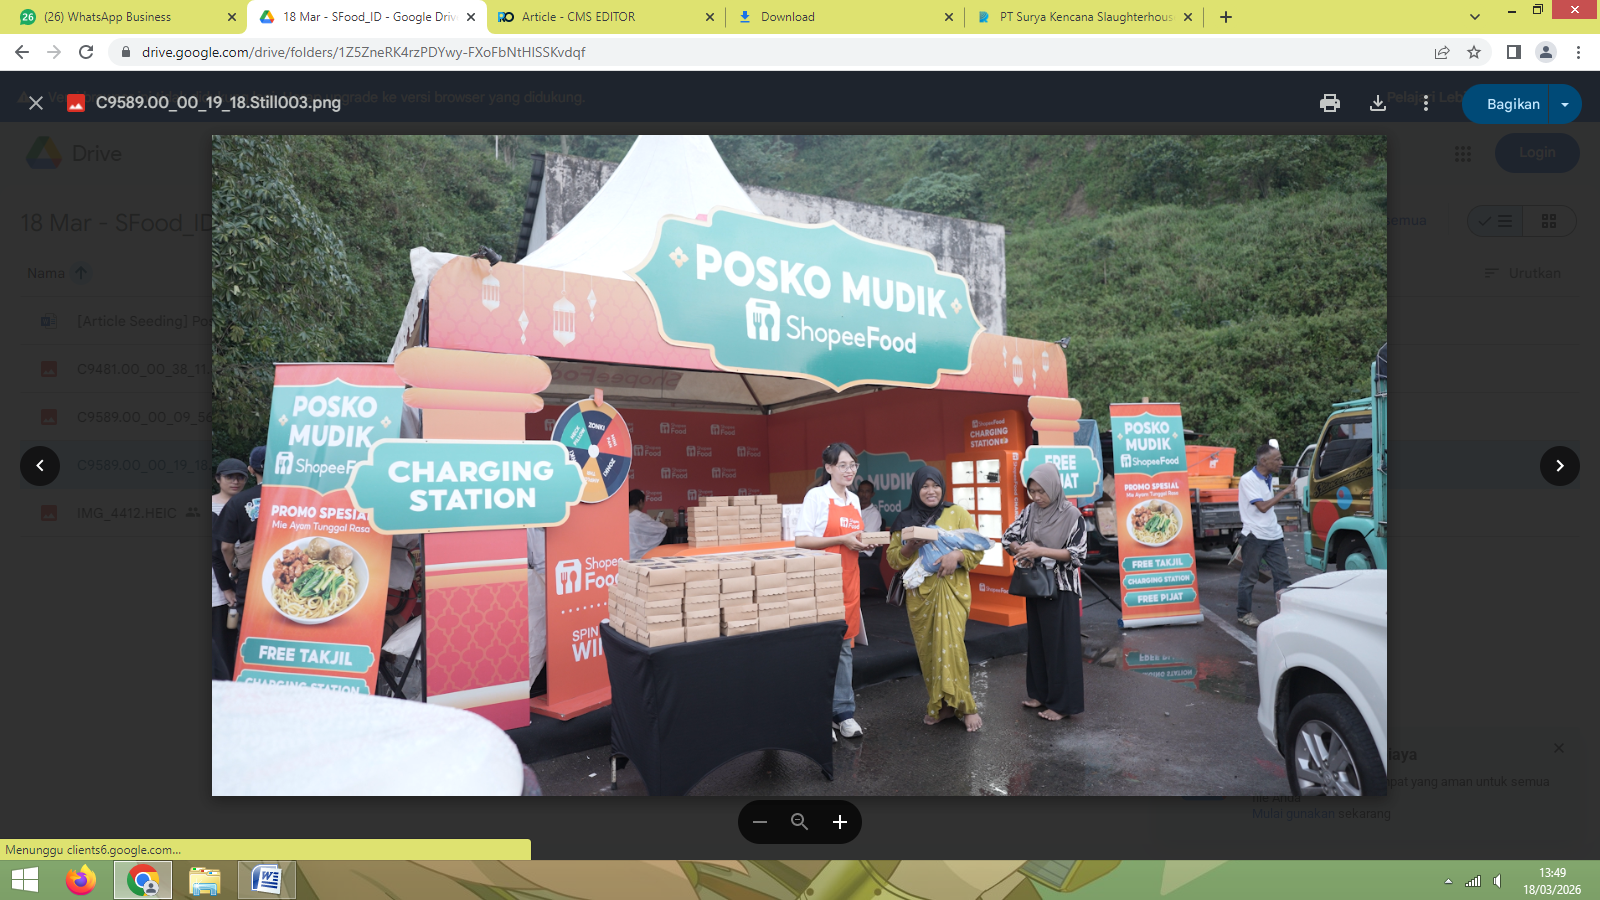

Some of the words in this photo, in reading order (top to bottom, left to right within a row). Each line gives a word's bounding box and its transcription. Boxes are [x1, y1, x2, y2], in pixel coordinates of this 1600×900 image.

[22, 11, 34, 22] 26
[45, 11, 65, 24] (26)
[68, 11, 123, 25] WhatsApp
[126, 11, 172, 22] Business
[284, 11, 296, 22] 18
[300, 11, 321, 22] Mar
[332, 11, 382, 24] SFood_ID
[393, 11, 432, 25] Google
[435, 11, 457, 22] Driv
[522, 11, 556, 22] Article
[568, 11, 592, 22] CMS
[596, 11, 636, 22] EDITOR
[761, 11, 815, 22] Download
[1001, 11, 1014, 22] PT
[1017, 11, 1046, 25] Surya
[1050, 11, 1093, 22] Kencana
[1487, 97, 1540, 113] Bagikan
[73, 144, 122, 162] Drive
[1520, 145, 1556, 161] Login
[21, 213, 42, 232] 18
[50, 213, 92, 232] Mar
[27, 267, 65, 279] Nama
[1509, 266, 1561, 279] Urutkan
[696, 243, 832, 300] POSKO
[842, 270, 947, 319] MUDIK
[78, 313, 126, 330] [Article
[130, 313, 188, 330] Seeding]
[786, 314, 917, 354] ShopeeFood
[77, 363, 212, 377] C9481.00_00_38_11.
[292, 395, 378, 418] POSKO
[970, 427, 1008, 438] CHARGING
[1124, 421, 1170, 434] POSKO
[288, 424, 374, 448] MUDIK
[970, 438, 1000, 448] STATION
[1126, 438, 1172, 451] MUDIK
[296, 458, 356, 478] ShopeeF
[1045, 454, 1076, 470] FREE
[1132, 456, 1180, 468] ShopeeFood
[388, 460, 554, 483] CHARGING
[1152, 482, 1179, 490] SPESIAL
[409, 488, 536, 512] STATION
[77, 507, 177, 522] IMG_4412.HEIC
[271, 504, 316, 518] PROMO
[272, 520, 287, 529] Mie
[289, 521, 310, 532] Ayam
[313, 522, 348, 534] Tunggal
[349, 524, 370, 533] Rasa
[1132, 560, 1154, 568] FREE
[1155, 558, 1184, 567] TAKJIL
[1138, 594, 1158, 603] FREE
[1161, 592, 1184, 602] PIJAT
[572, 626, 598, 642] SPIN
[258, 645, 296, 662] FREE
[300, 648, 352, 666] TAKJIL
[1388, 748, 1418, 764] iaya
[1411, 778, 1438, 790] yang
[1442, 778, 1473, 787] aman
[1476, 777, 1508, 787] untuk
[1511, 778, 1550, 787] semua
[1252, 807, 1283, 819] Mulai
[1287, 807, 1335, 822] gunakan
[1339, 807, 1391, 822] sekarang
[5, 844, 64, 858] Menunggu
[67, 844, 182, 858] clients6.google.com...
[1539, 867, 1567, 878] 13:49
[1523, 884, 1582, 896] 18/03/2026
